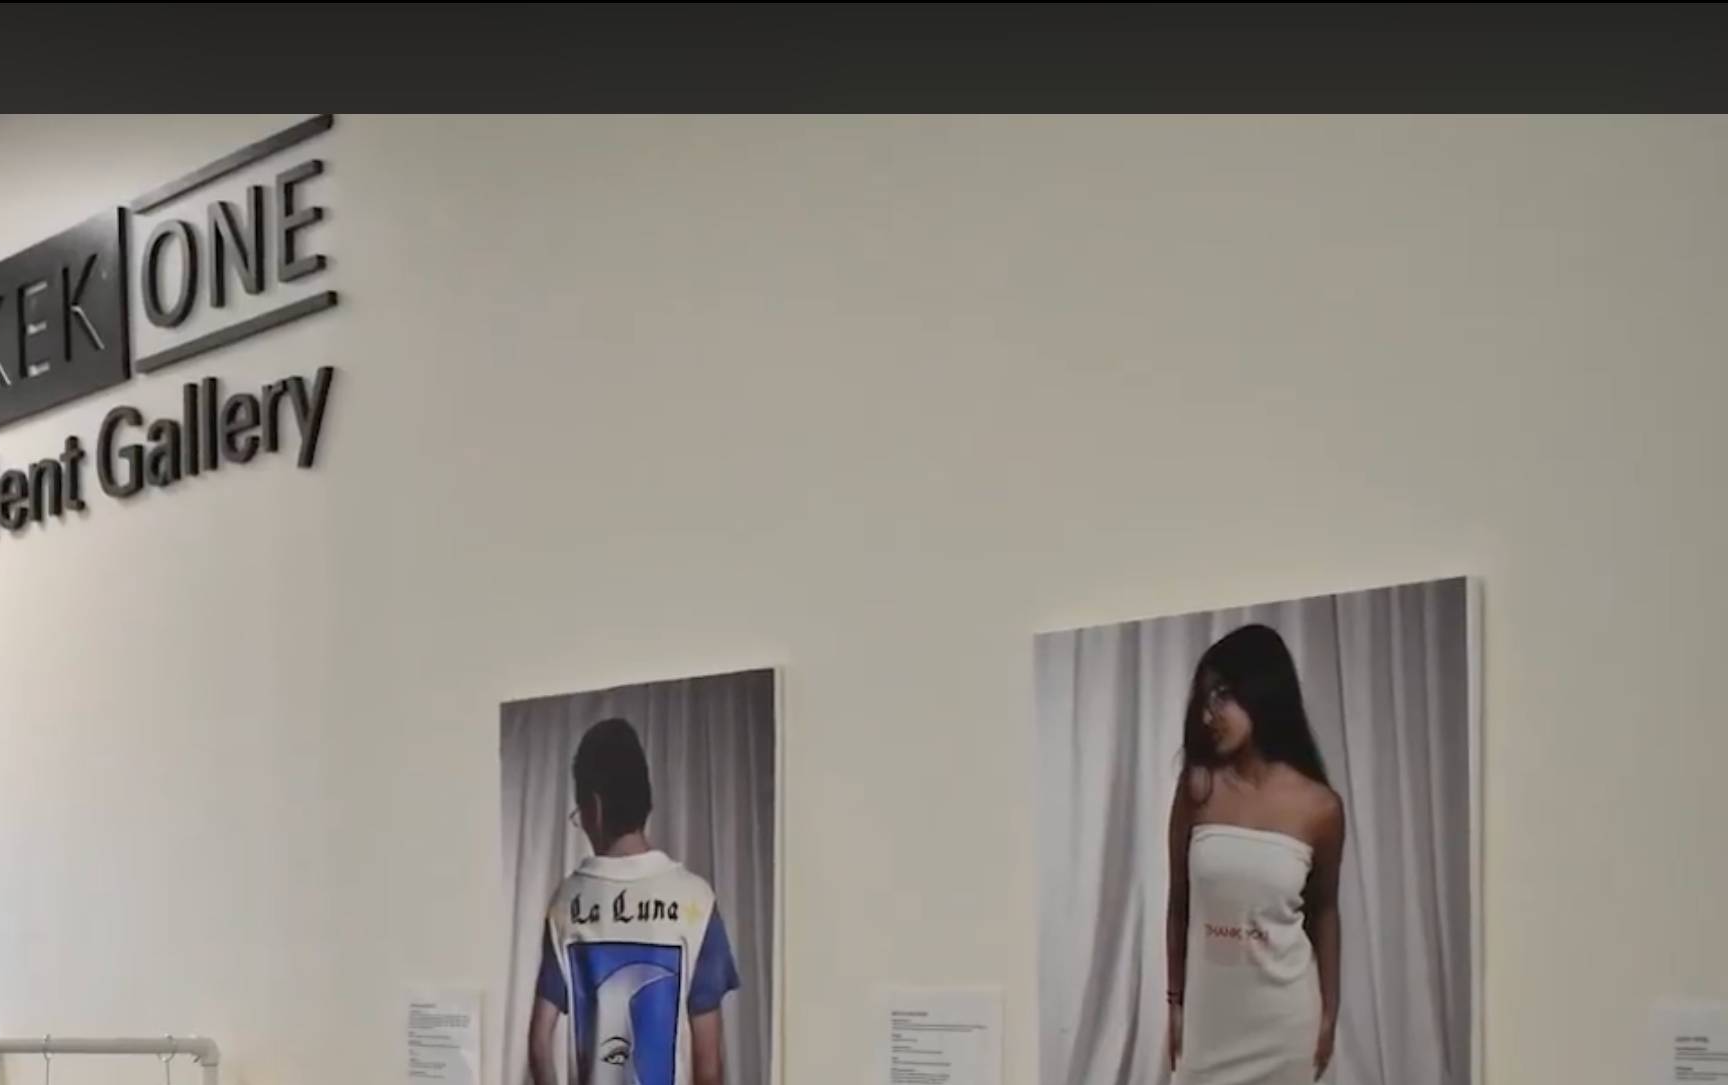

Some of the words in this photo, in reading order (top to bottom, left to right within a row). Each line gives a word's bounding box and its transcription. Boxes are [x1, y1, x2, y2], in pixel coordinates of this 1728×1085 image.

[140, 157, 328, 330] ONE
[95, 365, 336, 499] Gallery
[570, 892, 601, 925] La
[612, 887, 680, 925] Luna
